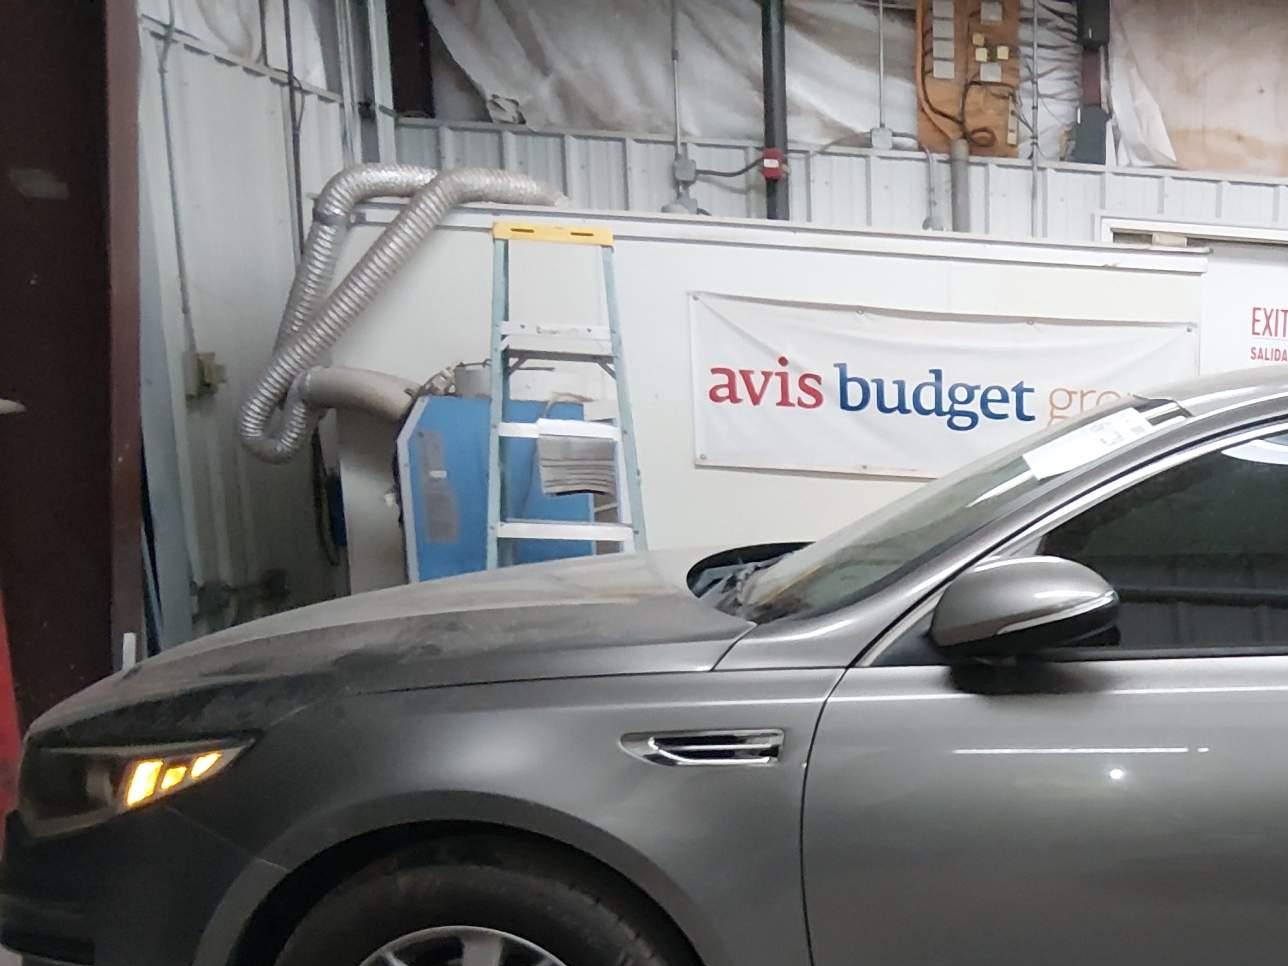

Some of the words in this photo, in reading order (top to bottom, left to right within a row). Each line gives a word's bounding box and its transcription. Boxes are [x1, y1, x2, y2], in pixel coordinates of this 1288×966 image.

[1249, 346, 1288, 362] SALIDA
[709, 356, 823, 409] avis
[834, 363, 1036, 432] budget
